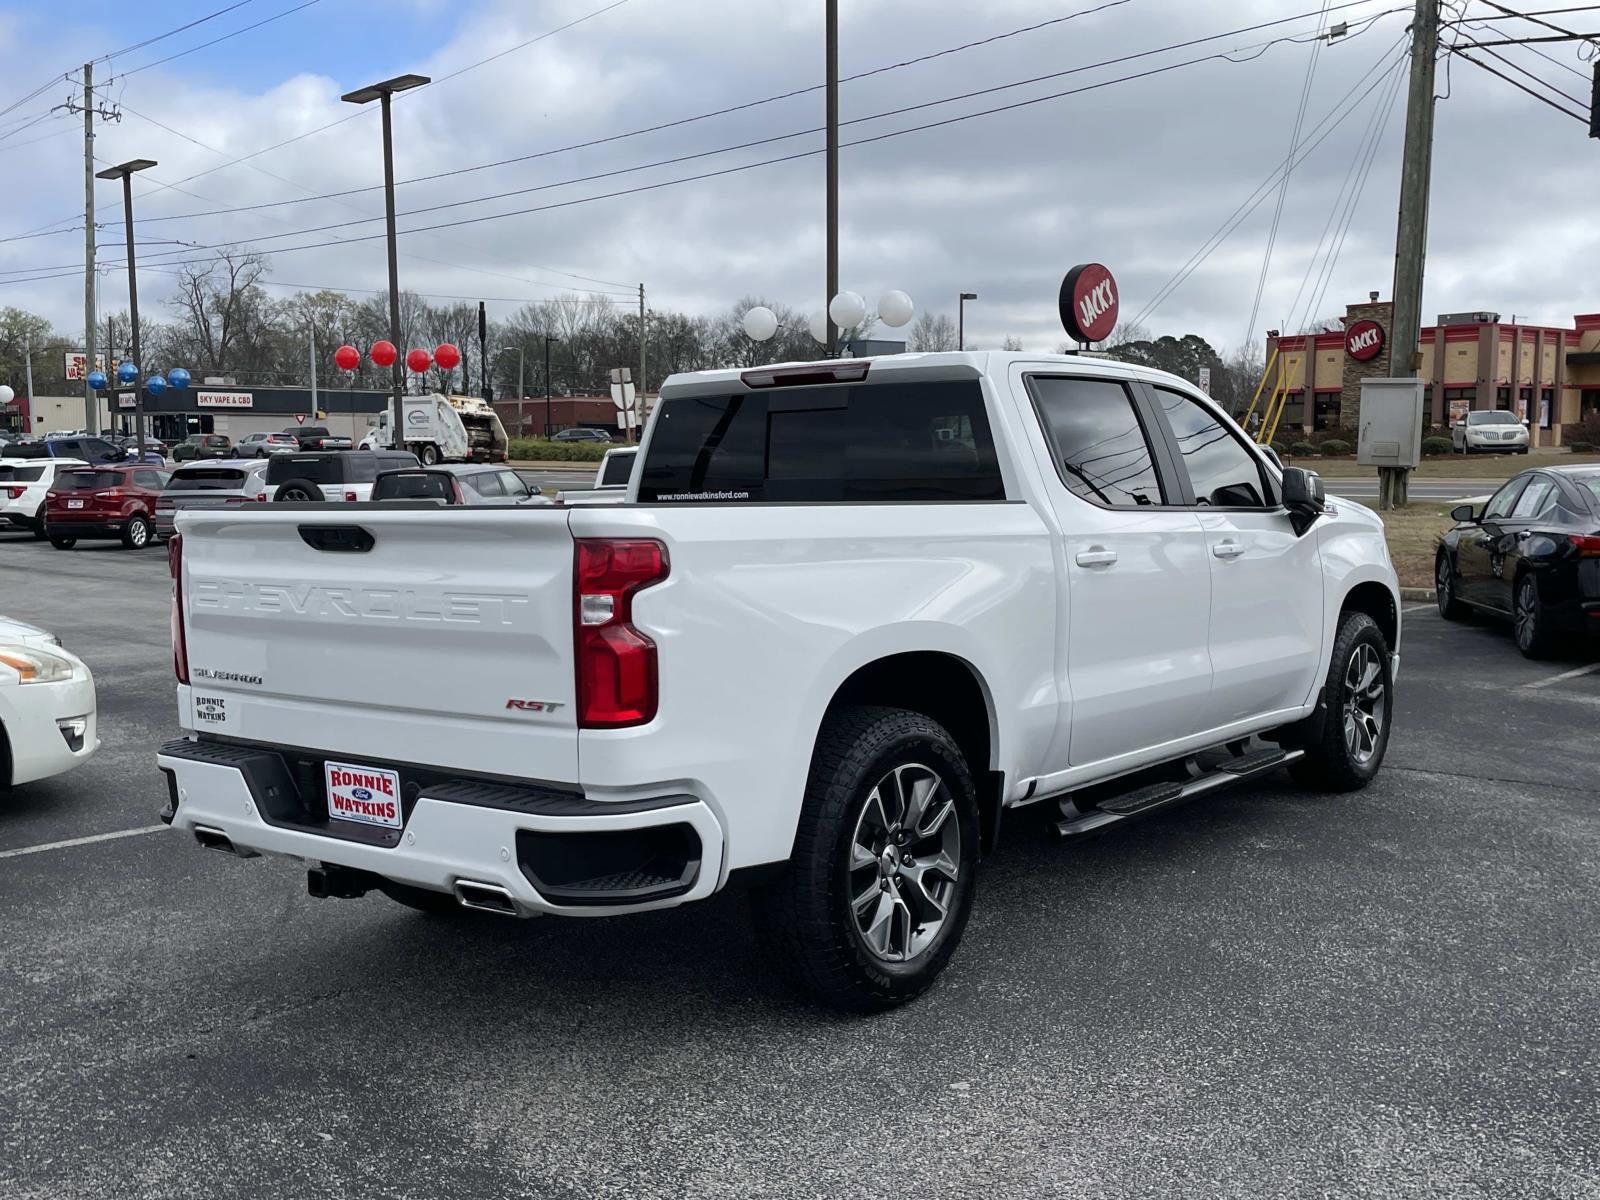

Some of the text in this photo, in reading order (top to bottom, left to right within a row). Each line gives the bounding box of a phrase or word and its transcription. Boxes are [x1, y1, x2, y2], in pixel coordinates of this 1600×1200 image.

[200, 395, 251, 405] SKY VAPE & CBD
[656, 490, 749, 501] www.ronniewatkinsford.com
[195, 581, 529, 625] CHEVROLET
[196, 696, 225, 709] RONNIE
[505, 699, 565, 713] RST
[196, 708, 226, 722] WATKINS
[330, 770, 394, 798] RONNIE
[355, 789, 370, 800] Ford
[332, 792, 396, 819] WATKINS
